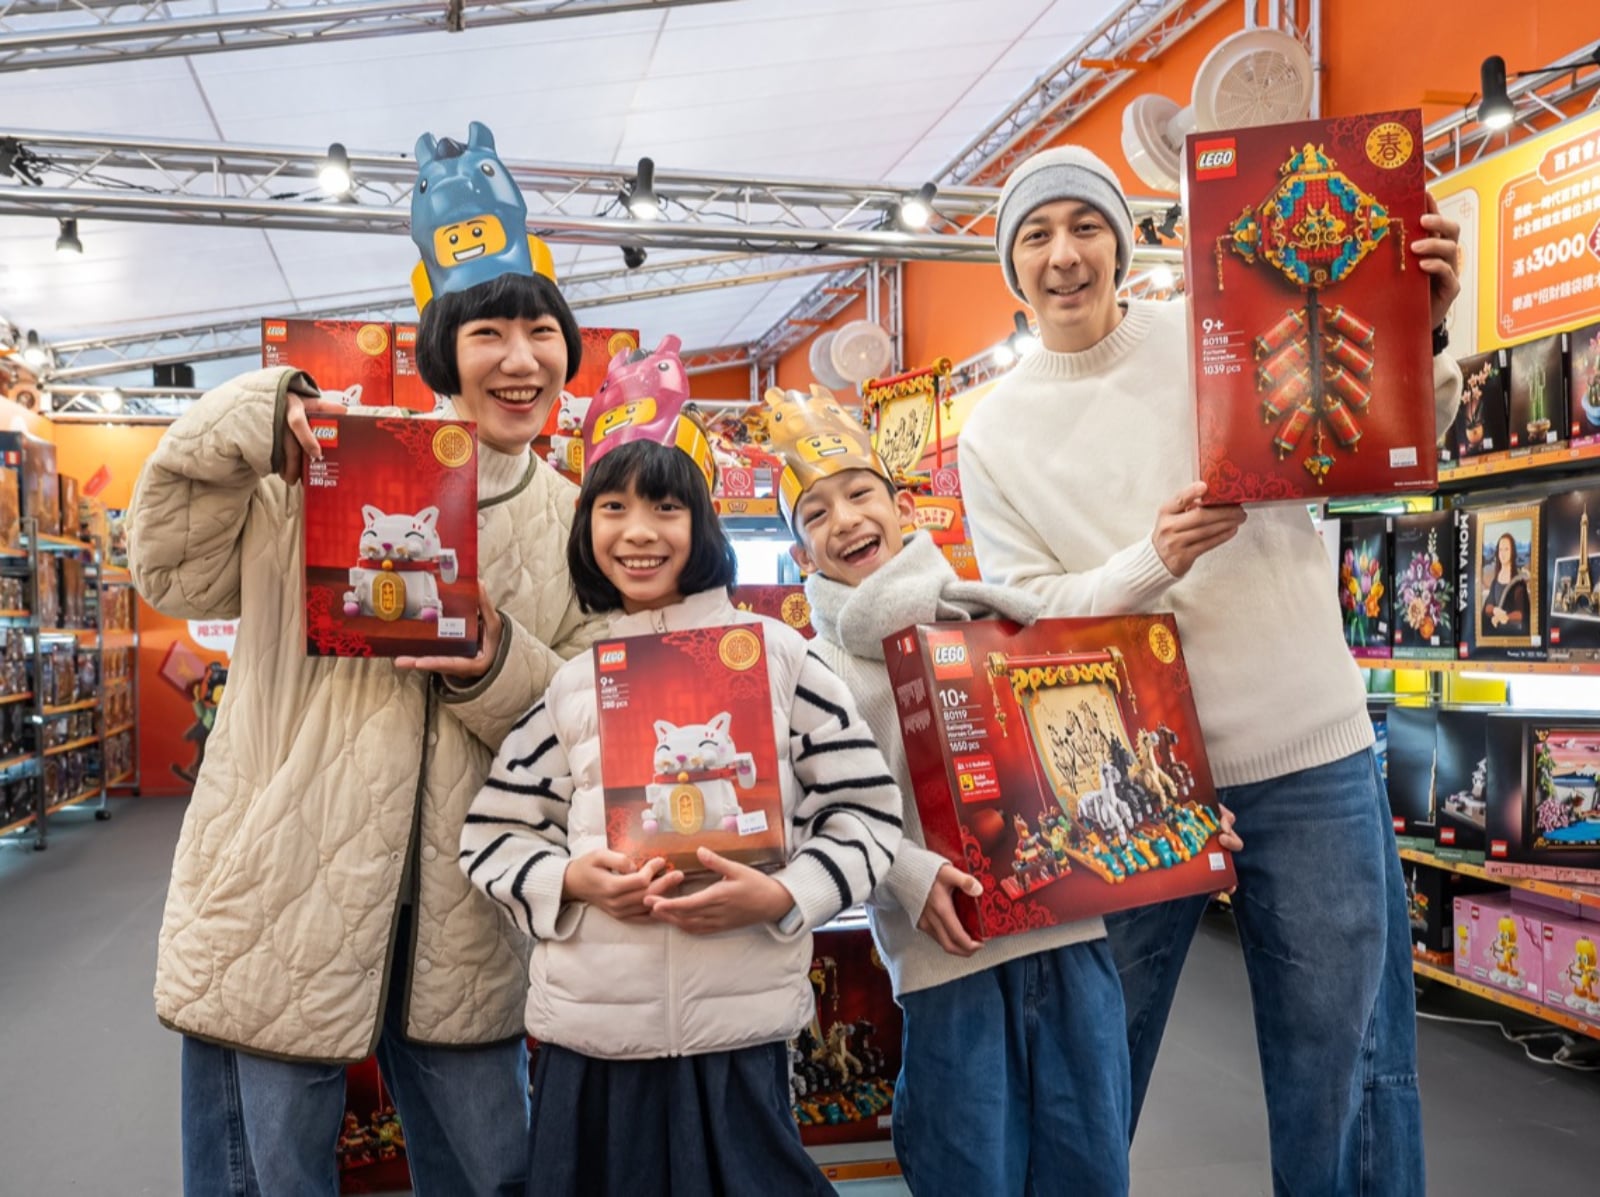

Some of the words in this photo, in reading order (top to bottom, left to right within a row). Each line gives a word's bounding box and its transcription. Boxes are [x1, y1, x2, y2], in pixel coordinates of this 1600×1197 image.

[1376, 131, 1402, 161] 春
[1198, 149, 1234, 169] LEGO
[1202, 318, 1225, 334] 9+
[1203, 364, 1225, 375] 1039
[1226, 365, 1241, 375] pcs
[313, 426, 338, 440] LEGO
[1459, 513, 1470, 569] MONA
[1459, 573, 1469, 612] LISA
[600, 651, 626, 664] LEGO
[934, 645, 966, 665] LEGO
[600, 676, 614, 687] 9+
[939, 688, 969, 707] 10+
[943, 710, 968, 721] 80119
[949, 741, 968, 752] 1650
[968, 741, 980, 751] pcs
